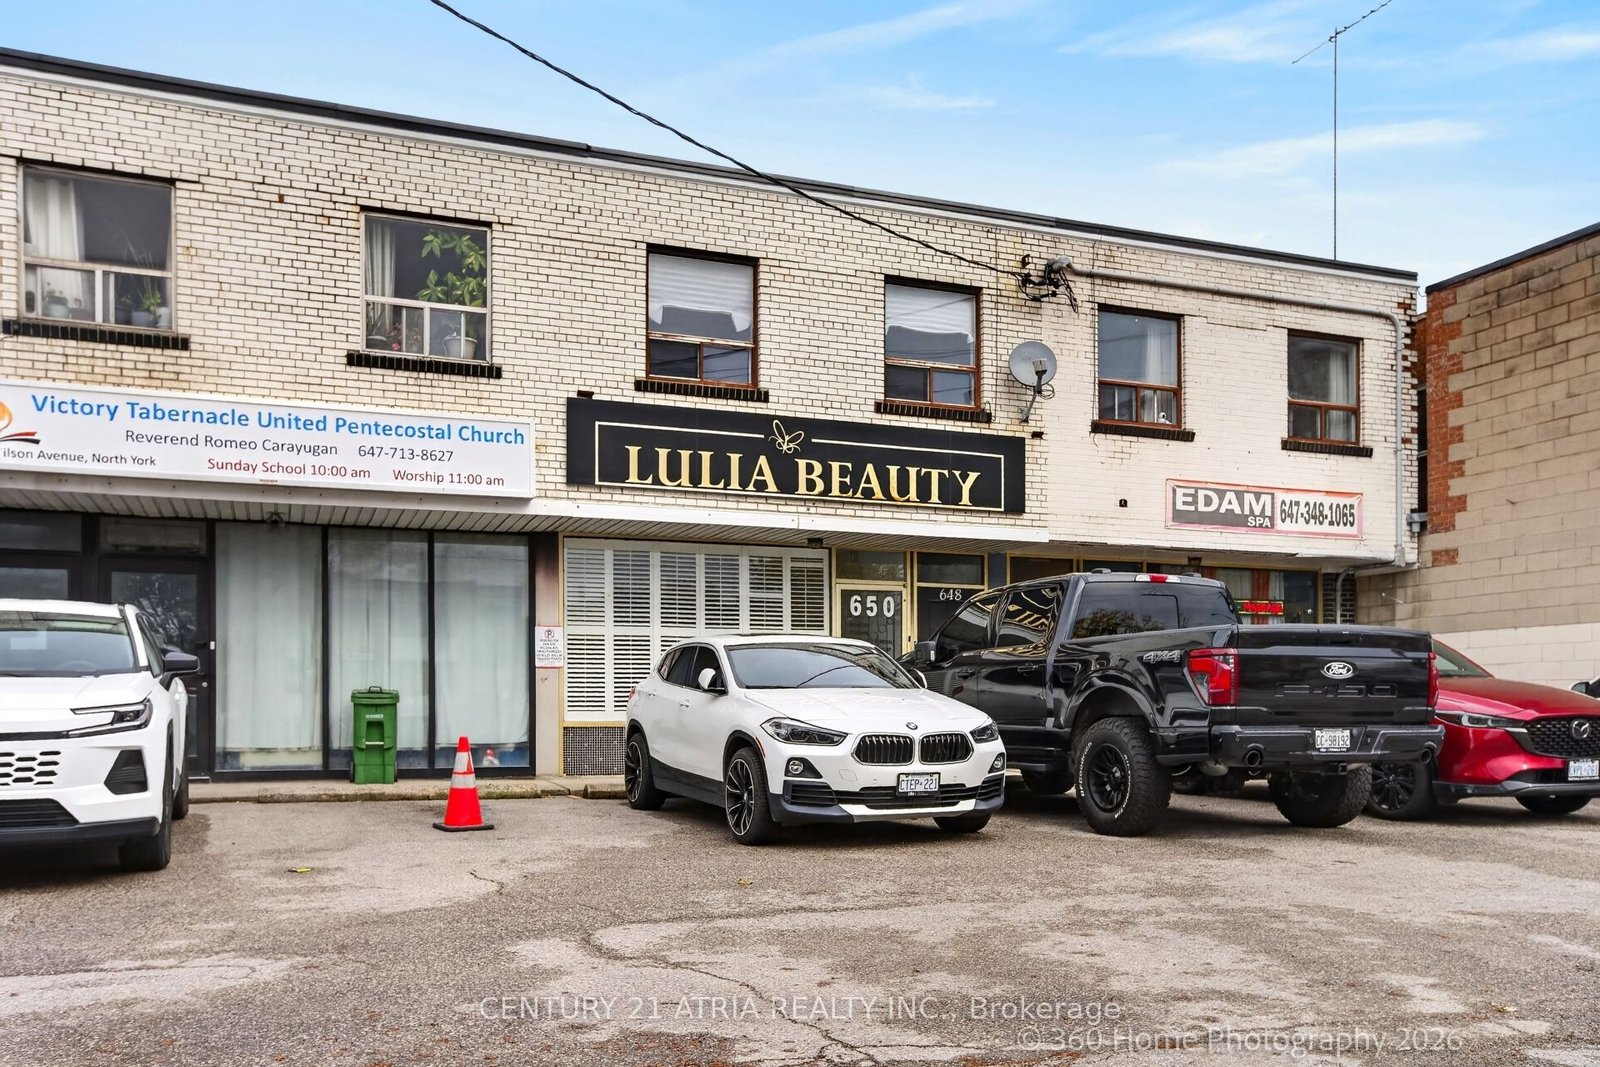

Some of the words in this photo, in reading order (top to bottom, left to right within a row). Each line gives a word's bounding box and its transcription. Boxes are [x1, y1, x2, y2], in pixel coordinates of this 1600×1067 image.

[32, 394, 119, 421] Victory
[127, 402, 250, 426] Tabernacle
[258, 411, 327, 432] United
[335, 417, 451, 440] Pentecostal
[458, 425, 525, 445] Church
[125, 430, 199, 447] Reverend
[204, 435, 257, 450] Romeo
[262, 439, 338, 457] Carayugan
[358, 445, 454, 462] 647-713-8627
[3, 447, 33, 459] ilson
[37, 450, 88, 464] Avenue,
[92, 453, 127, 465] North
[130, 454, 156, 467] York
[207, 458, 257, 474] Sunday
[261, 461, 306, 475] School
[310, 464, 347, 477] 10:00
[351, 468, 371, 478] am
[393, 469, 444, 484] Worship
[448, 473, 483, 486] 11:00
[486, 477, 505, 487] am
[624, 445, 781, 492] LULIA
[794, 458, 981, 506] BEAUTY
[1175, 487, 1272, 516] EDAM
[1247, 517, 1271, 528] SPA
[1280, 499, 1355, 528] 647-348-1065
[850, 594, 895, 618] 650
[939, 589, 962, 601] 648
